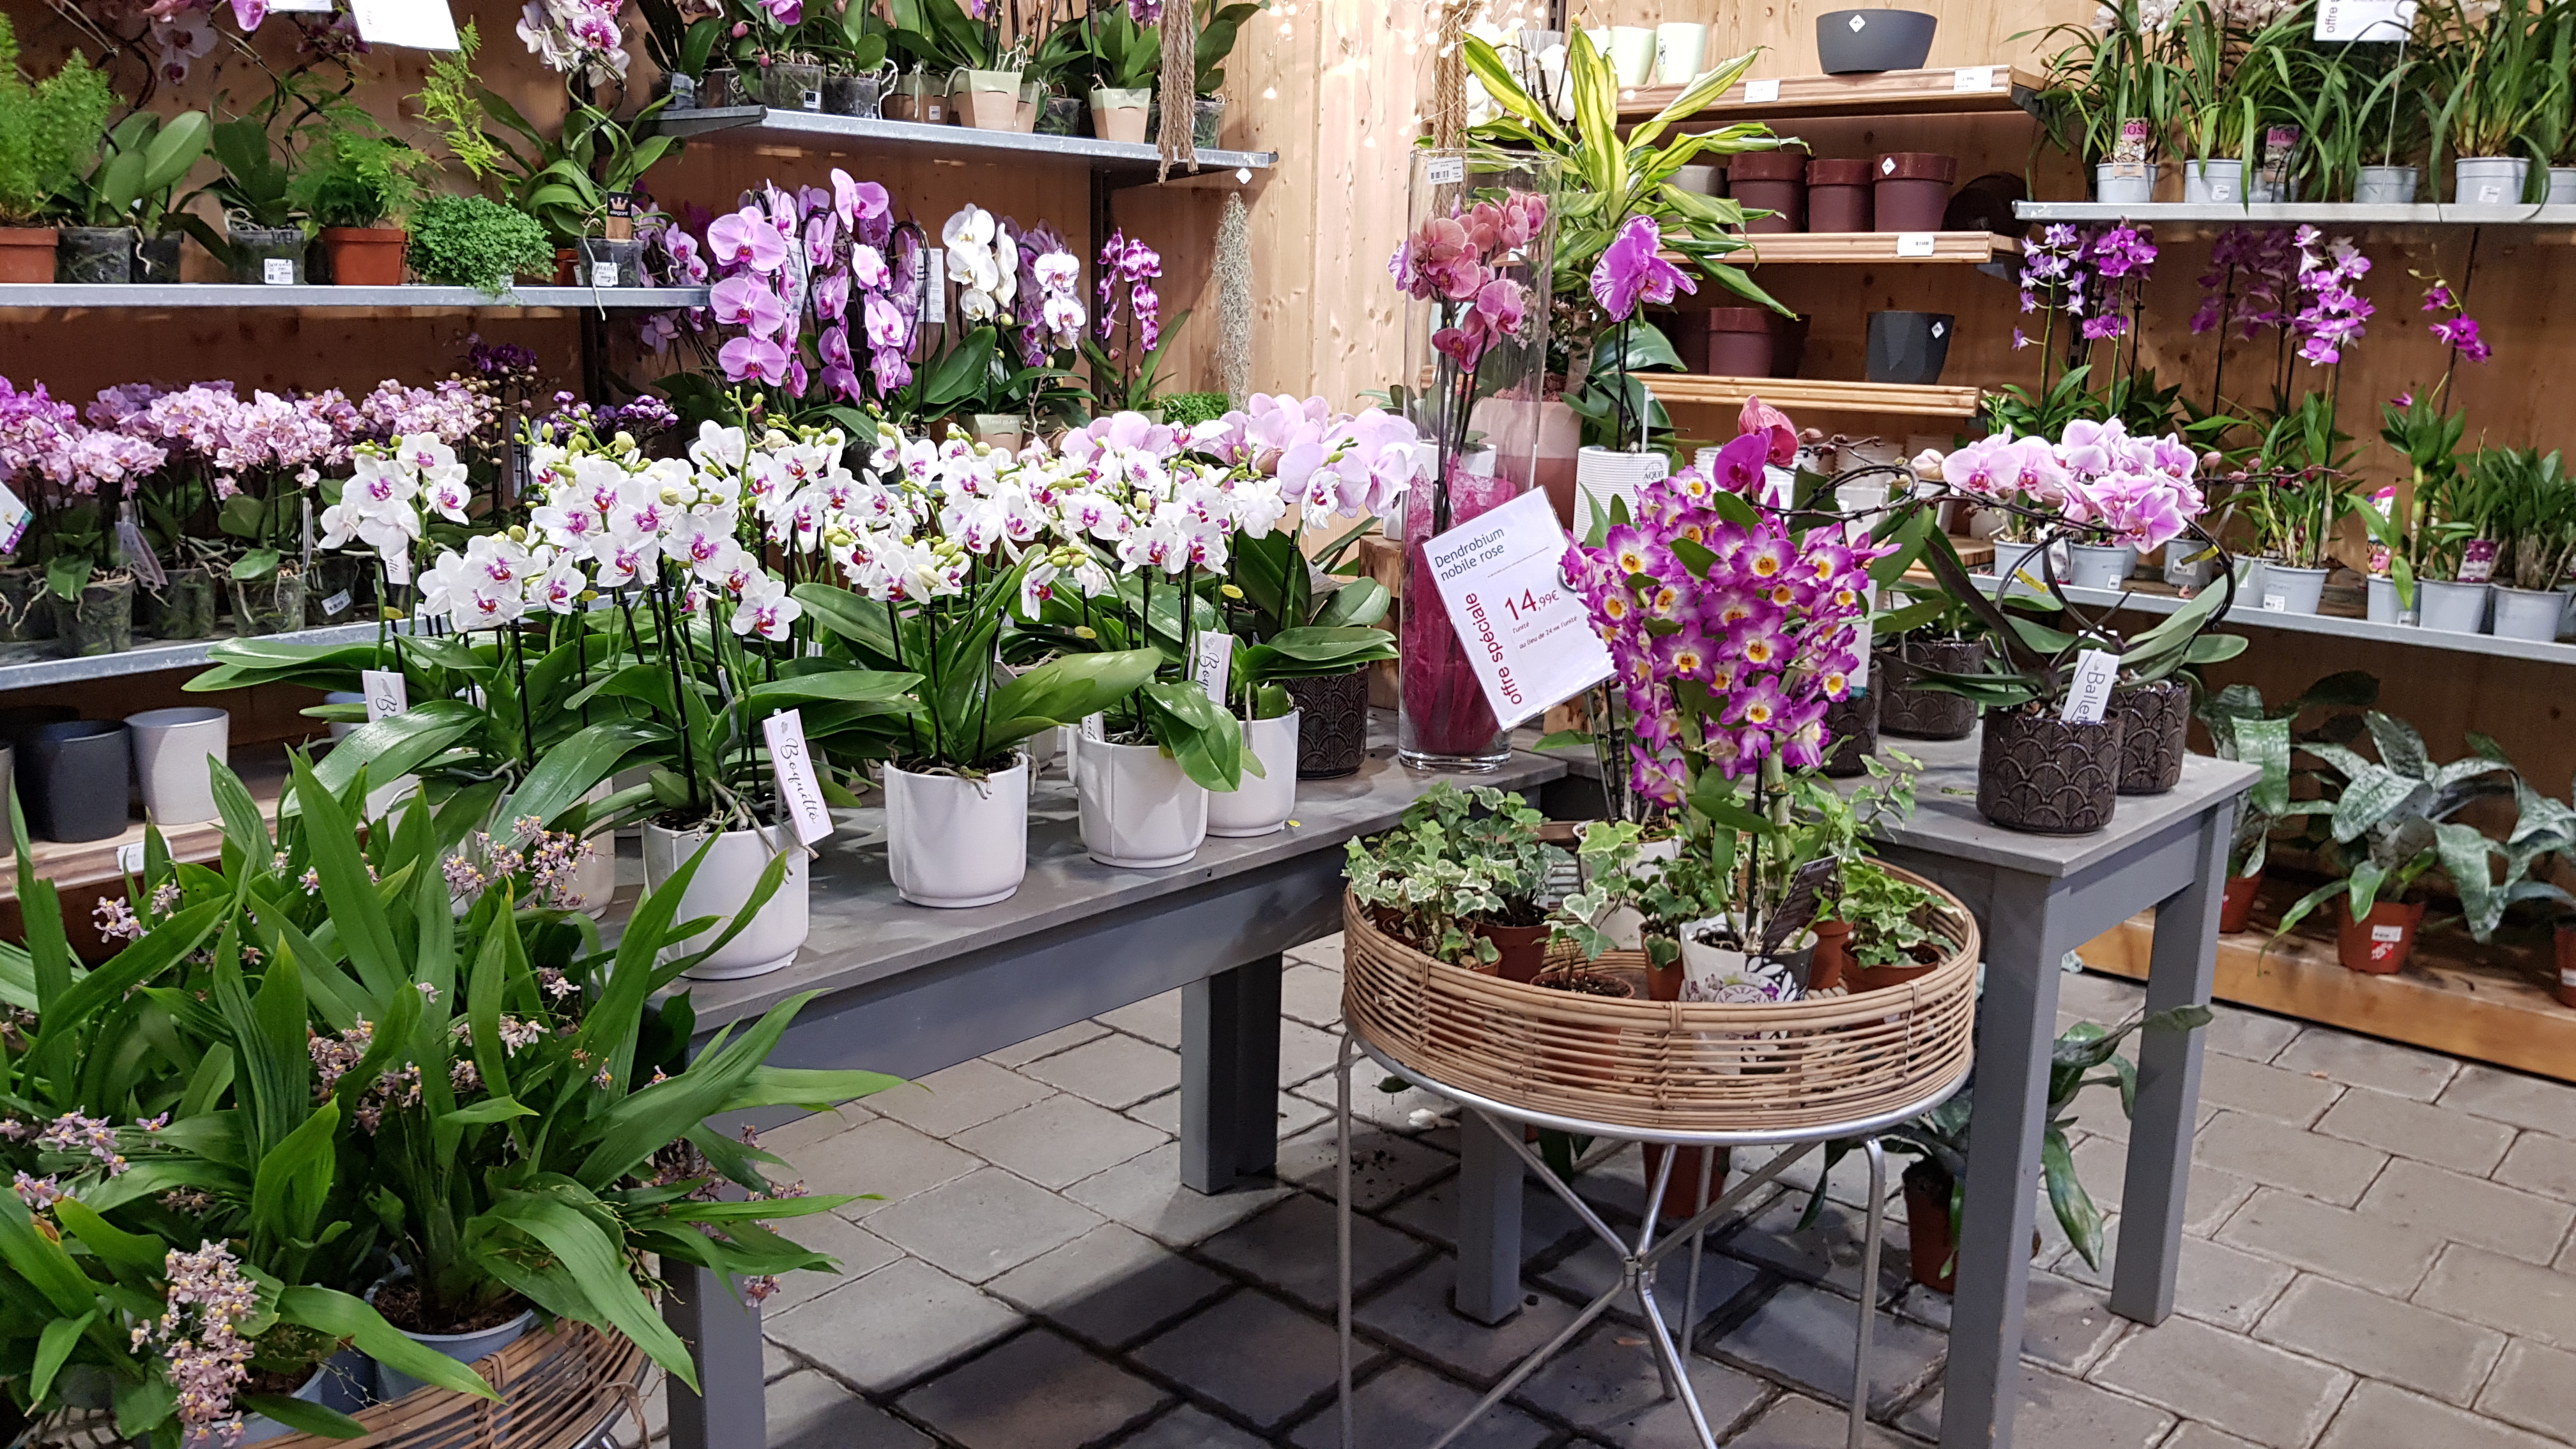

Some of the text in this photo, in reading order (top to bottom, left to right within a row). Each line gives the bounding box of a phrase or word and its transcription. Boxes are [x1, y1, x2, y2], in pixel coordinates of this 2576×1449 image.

[2325, 6, 2338, 33] offre
[1434, 528, 1505, 568] Dendrobium
[1441, 558, 1477, 581] nobile
[1480, 544, 1505, 563] rose
[1505, 588, 1560, 620] 14,99€
[1466, 592, 1522, 705] offre spéciale
[1526, 636, 1537, 646] lieu
